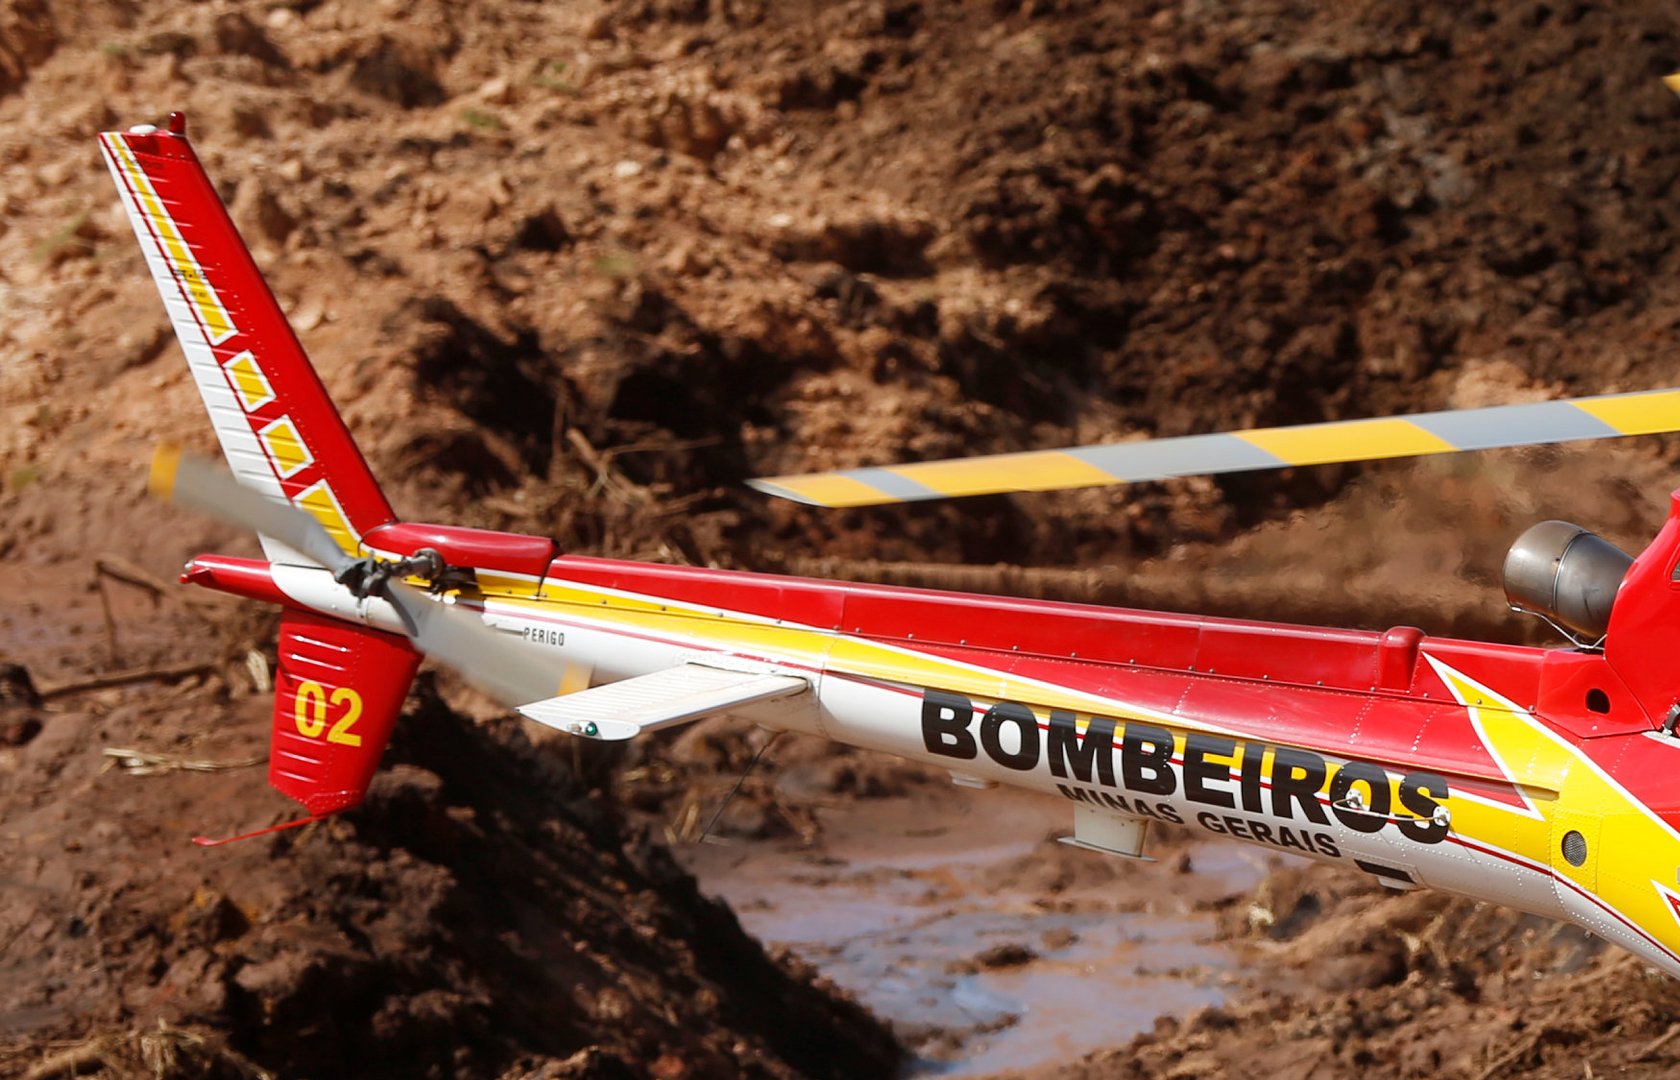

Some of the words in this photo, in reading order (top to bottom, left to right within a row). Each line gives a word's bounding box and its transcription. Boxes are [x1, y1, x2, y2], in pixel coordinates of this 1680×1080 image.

[524, 627, 565, 646] PERIGO
[295, 681, 362, 747] 02
[921, 686, 1450, 844] BOMBEIROS
[1056, 783, 1185, 825] MINAS
[1197, 811, 1342, 858] GERAIS
